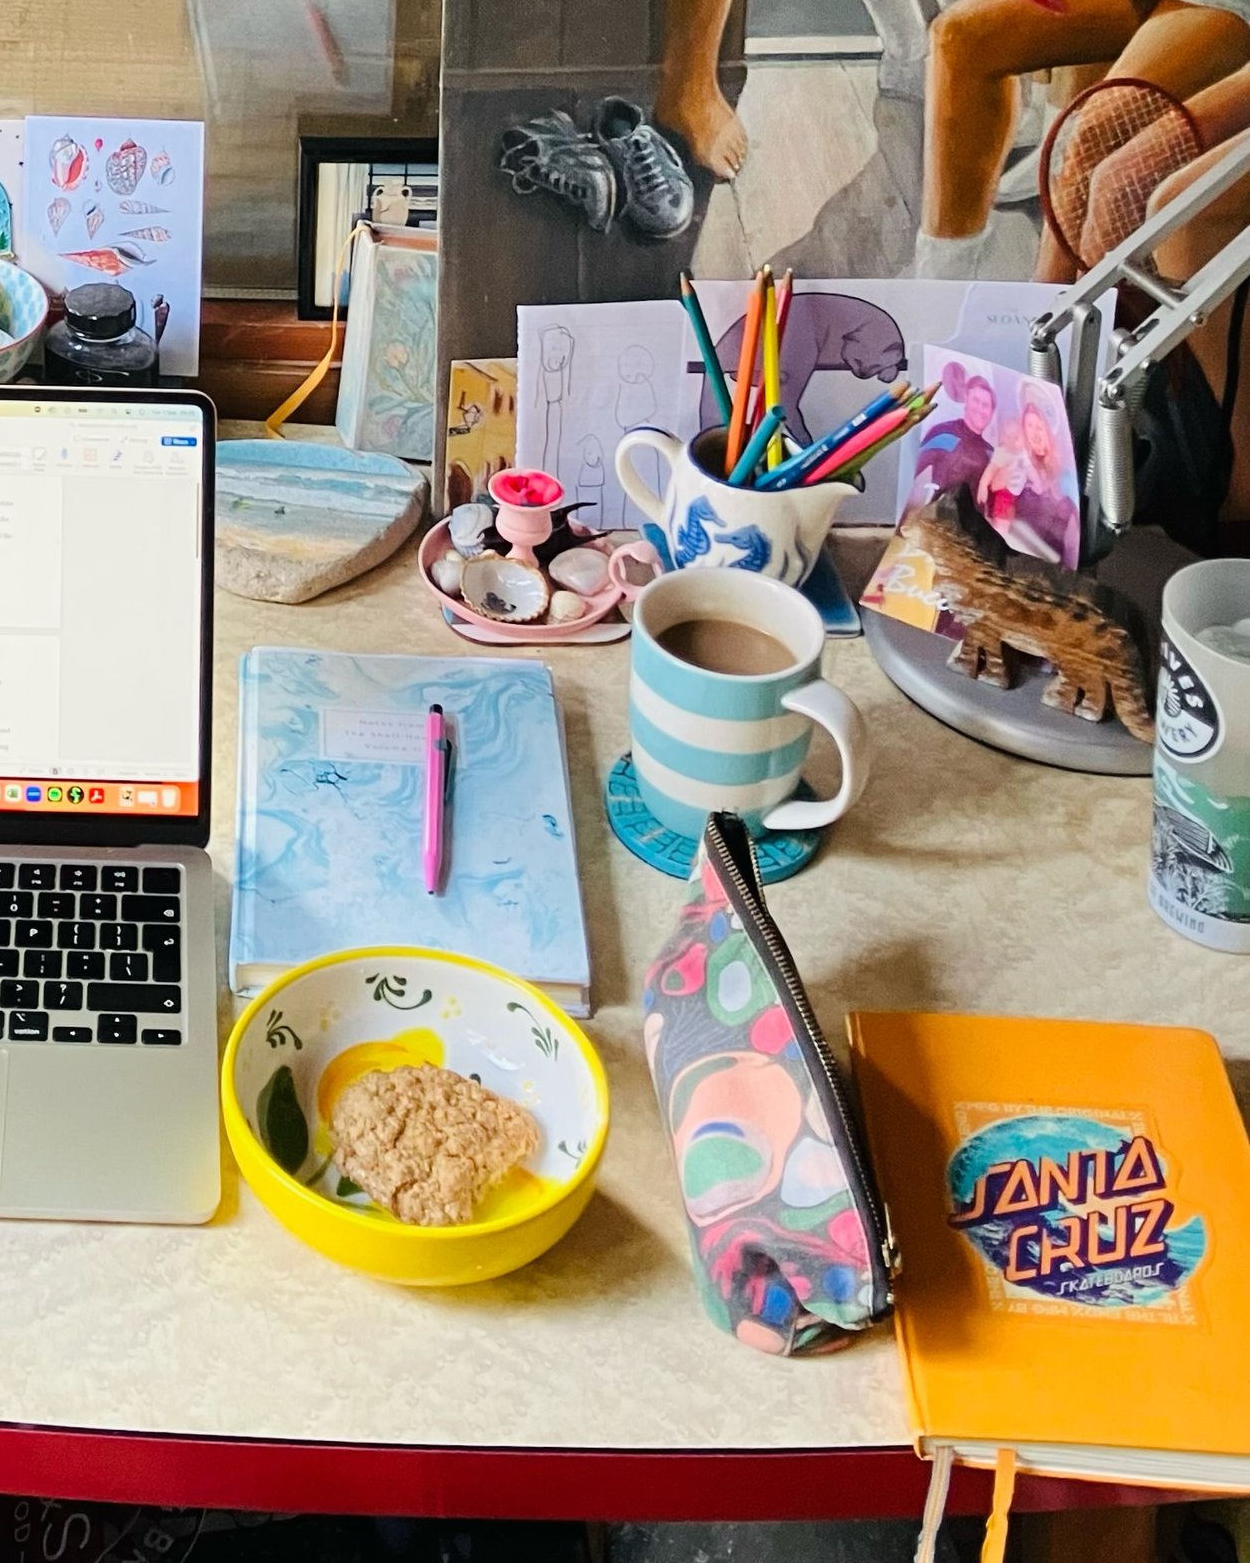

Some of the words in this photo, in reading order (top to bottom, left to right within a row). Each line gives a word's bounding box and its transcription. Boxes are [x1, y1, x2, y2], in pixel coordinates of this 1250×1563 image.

[29, 928, 39, 937] P
[953, 1135, 1164, 1224] SANTA
[1005, 1198, 1168, 1283] CRUZ
[1056, 1262, 1165, 1296] SKATEBOARDS
